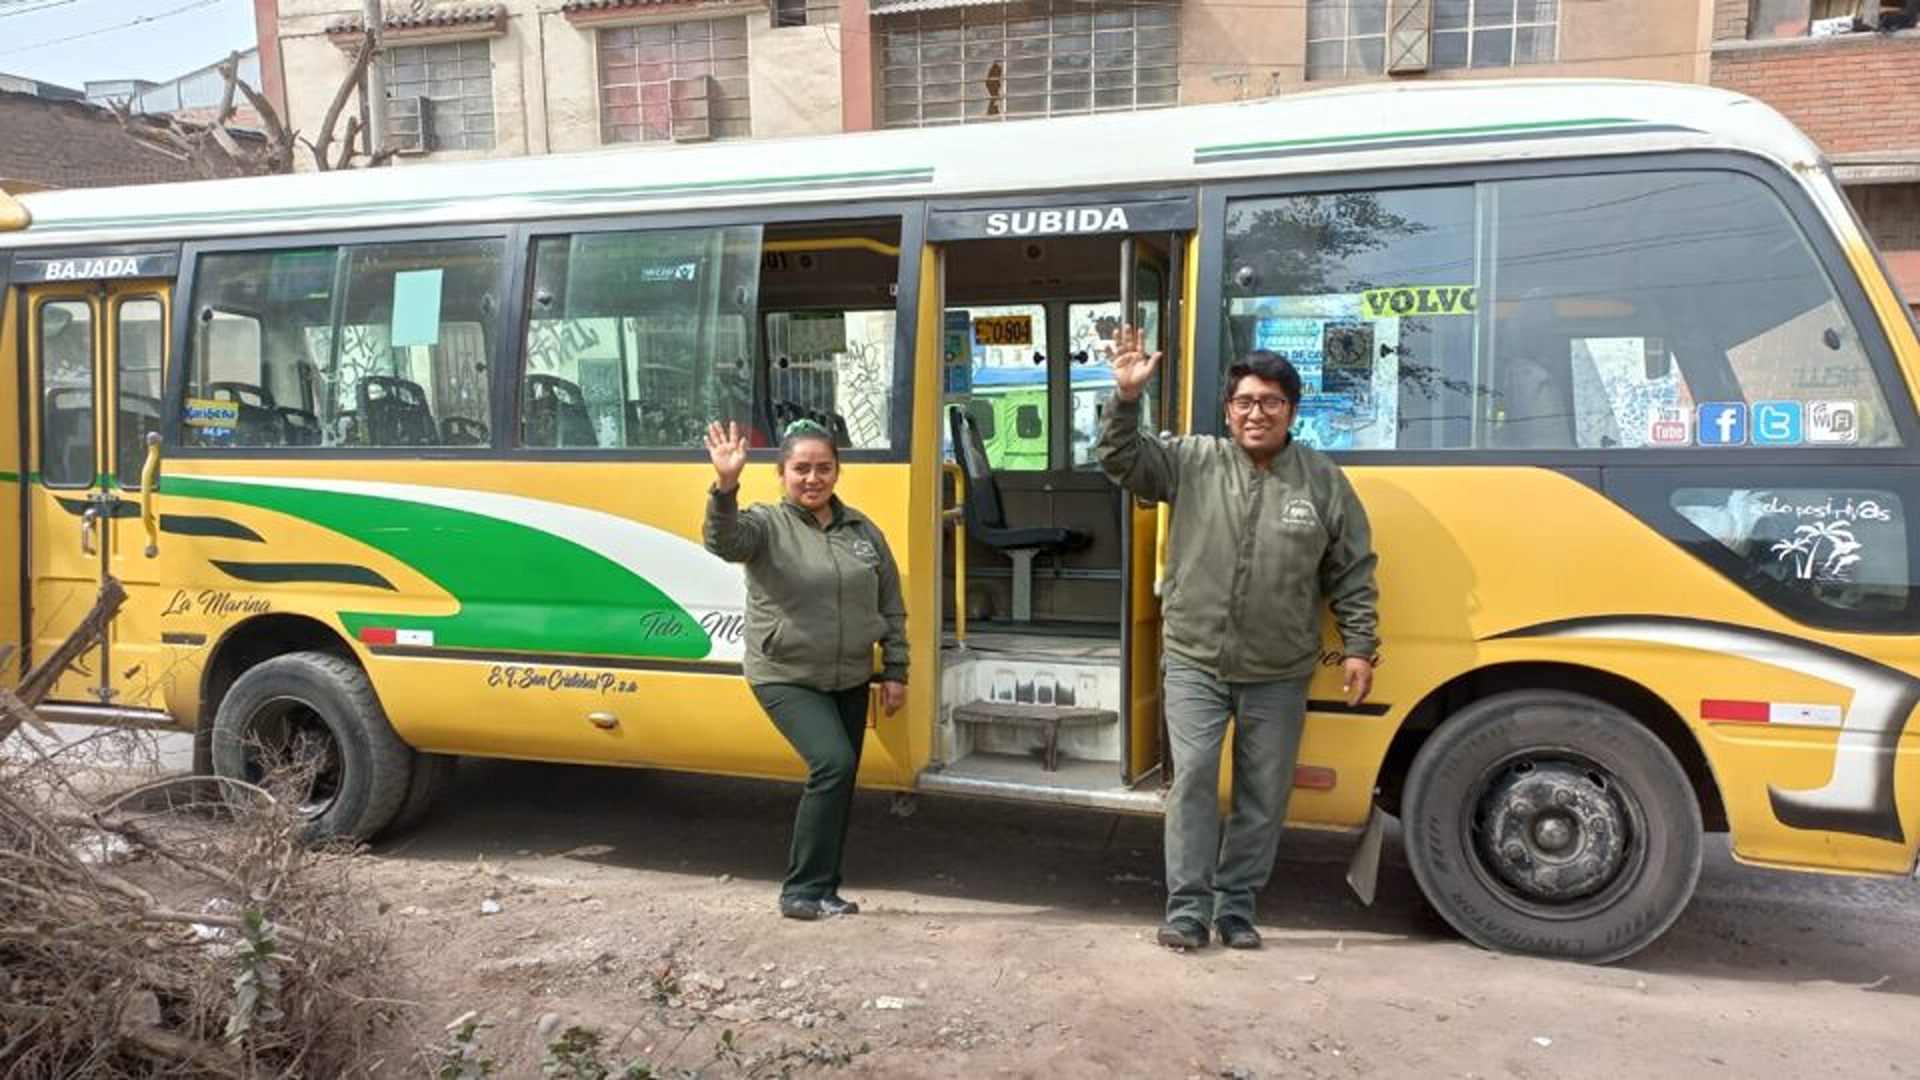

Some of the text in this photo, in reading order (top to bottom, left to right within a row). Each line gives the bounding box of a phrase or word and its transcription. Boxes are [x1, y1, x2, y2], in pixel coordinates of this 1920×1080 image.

[985, 207, 1129, 236] SUBIDA
[45, 257, 139, 281] BAJADA
[1654, 424, 1684, 440] Tube
[161, 589, 271, 617] La Marina
[519, 667, 546, 689] San
